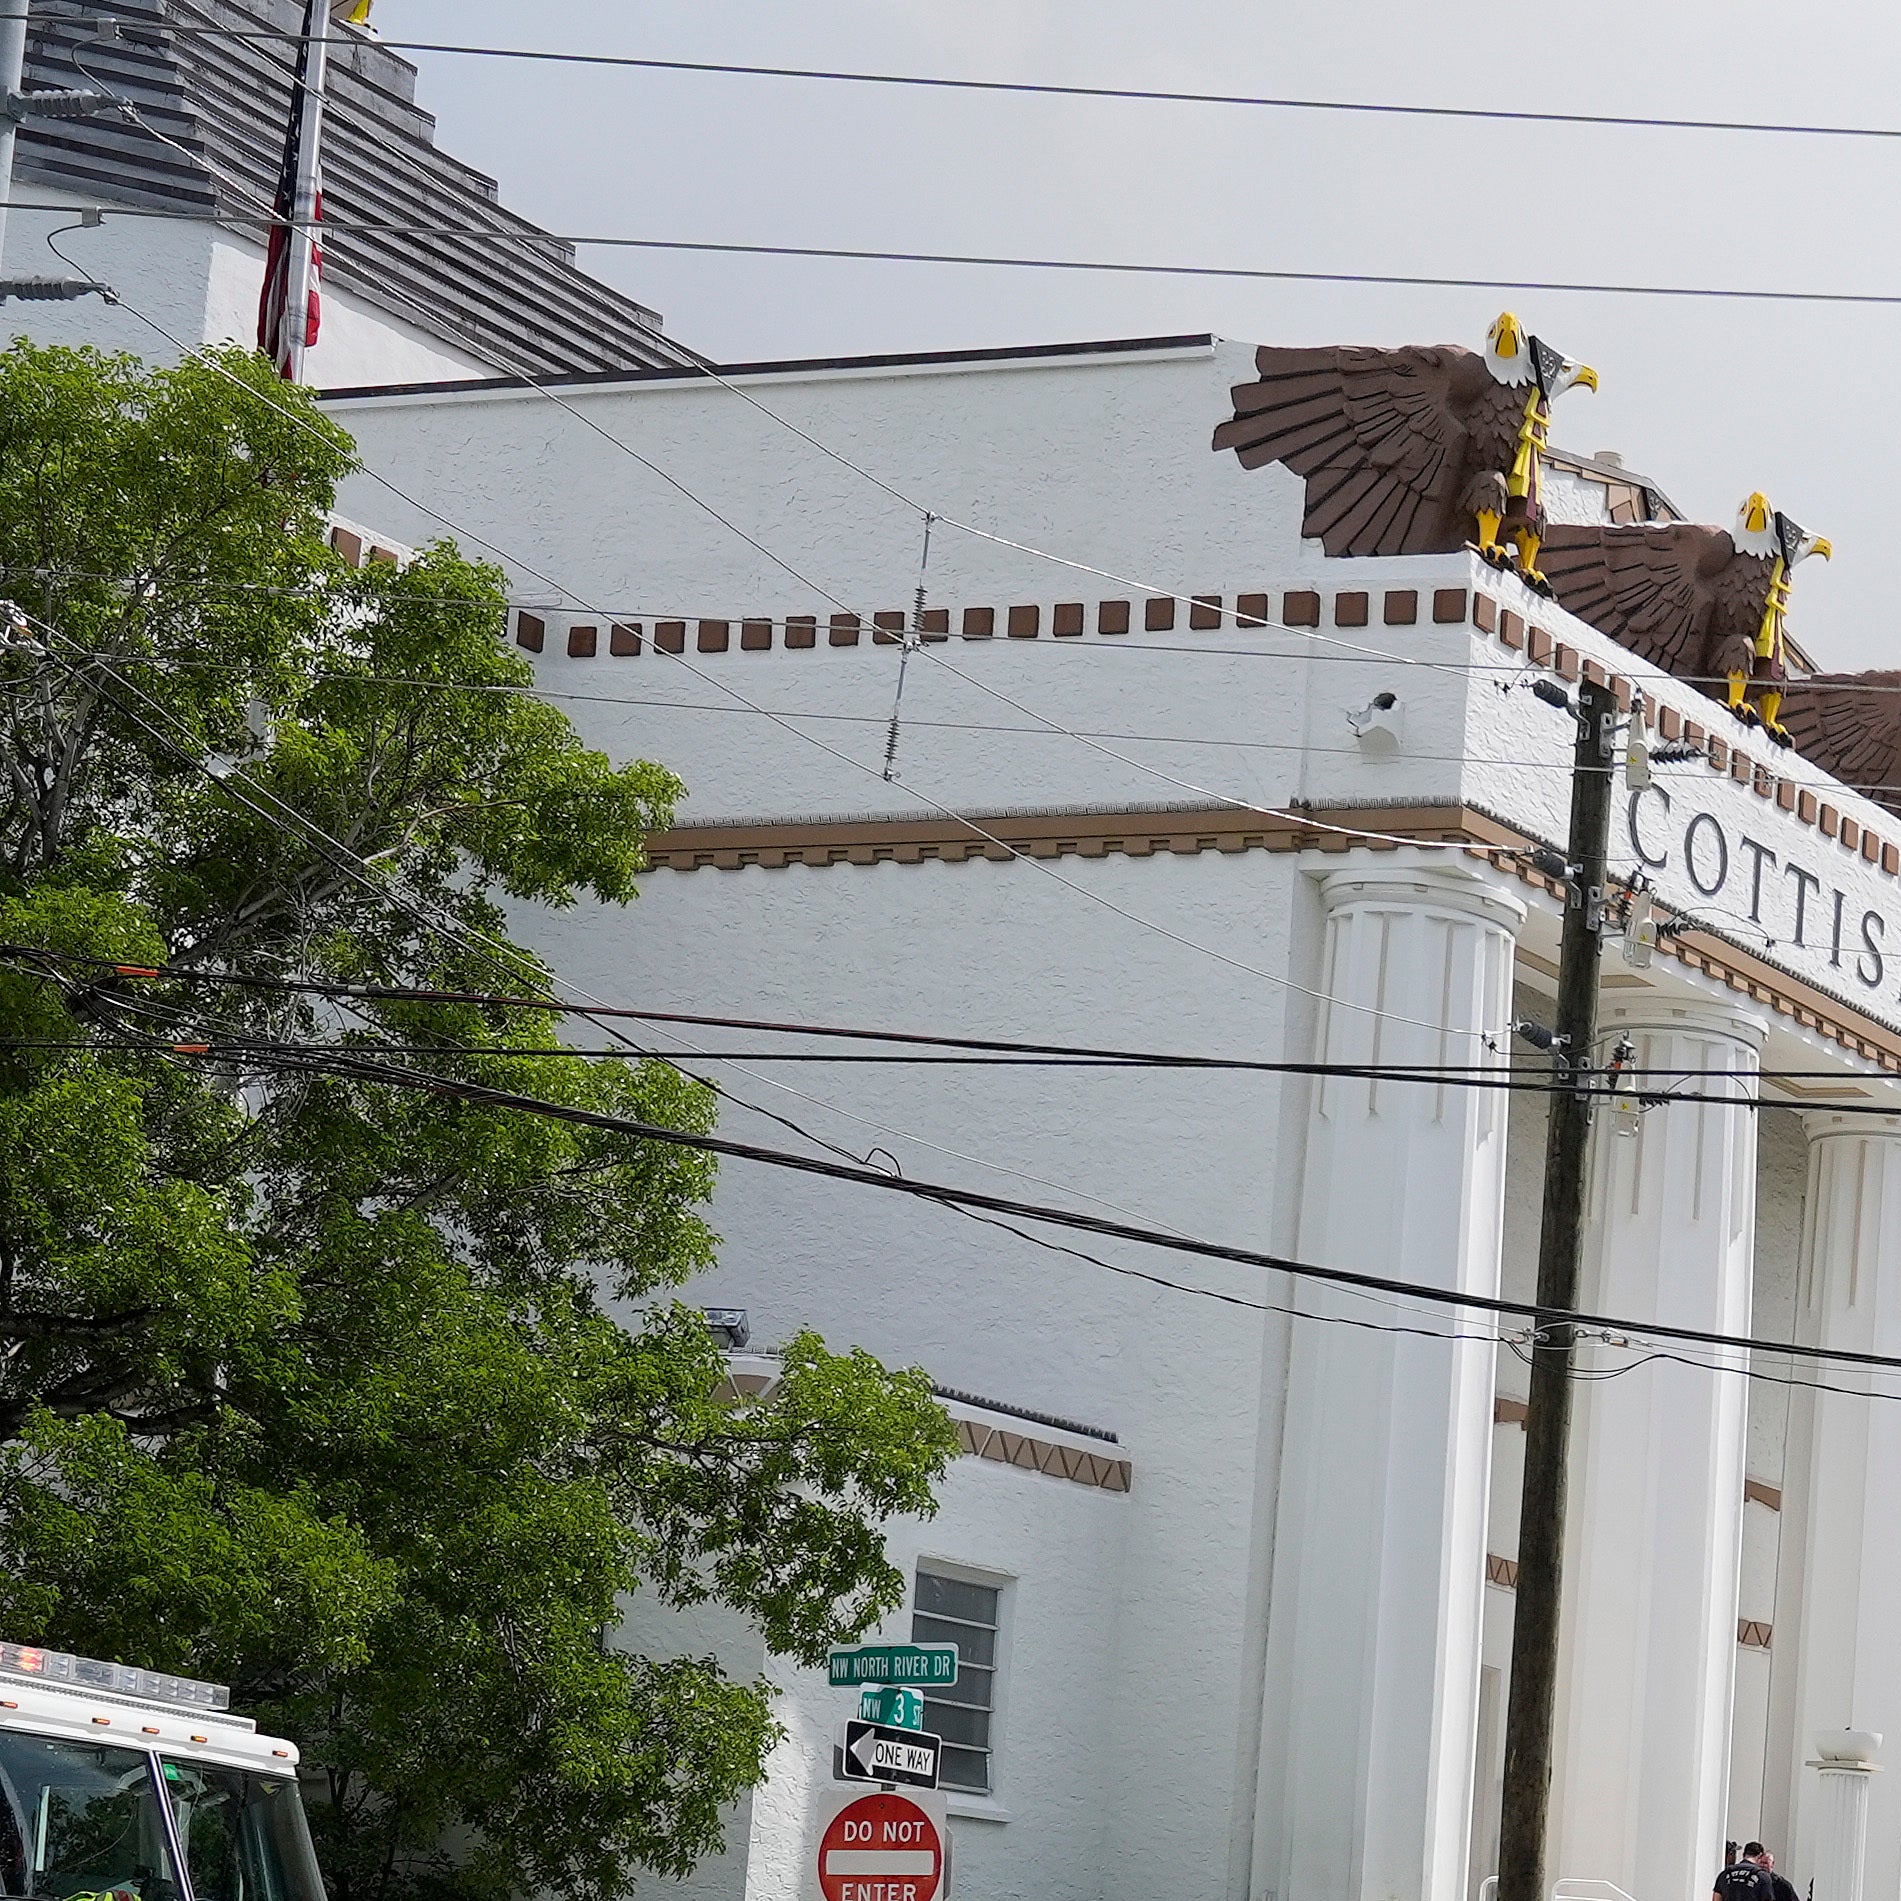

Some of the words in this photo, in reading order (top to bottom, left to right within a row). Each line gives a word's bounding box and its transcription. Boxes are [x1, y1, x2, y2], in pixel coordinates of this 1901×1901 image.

[832, 1658, 848, 1679] NW
[853, 1657, 889, 1678] NORTH
[894, 1656, 929, 1677] RIVER
[934, 1655, 950, 1677] DR
[862, 1697, 881, 1719] NW
[893, 1693, 905, 1724] 3
[875, 1742, 902, 1767] ONE
[907, 1750, 931, 1772] WAY
[844, 1820, 873, 1842] DO
[882, 1821, 925, 1843] NOT
